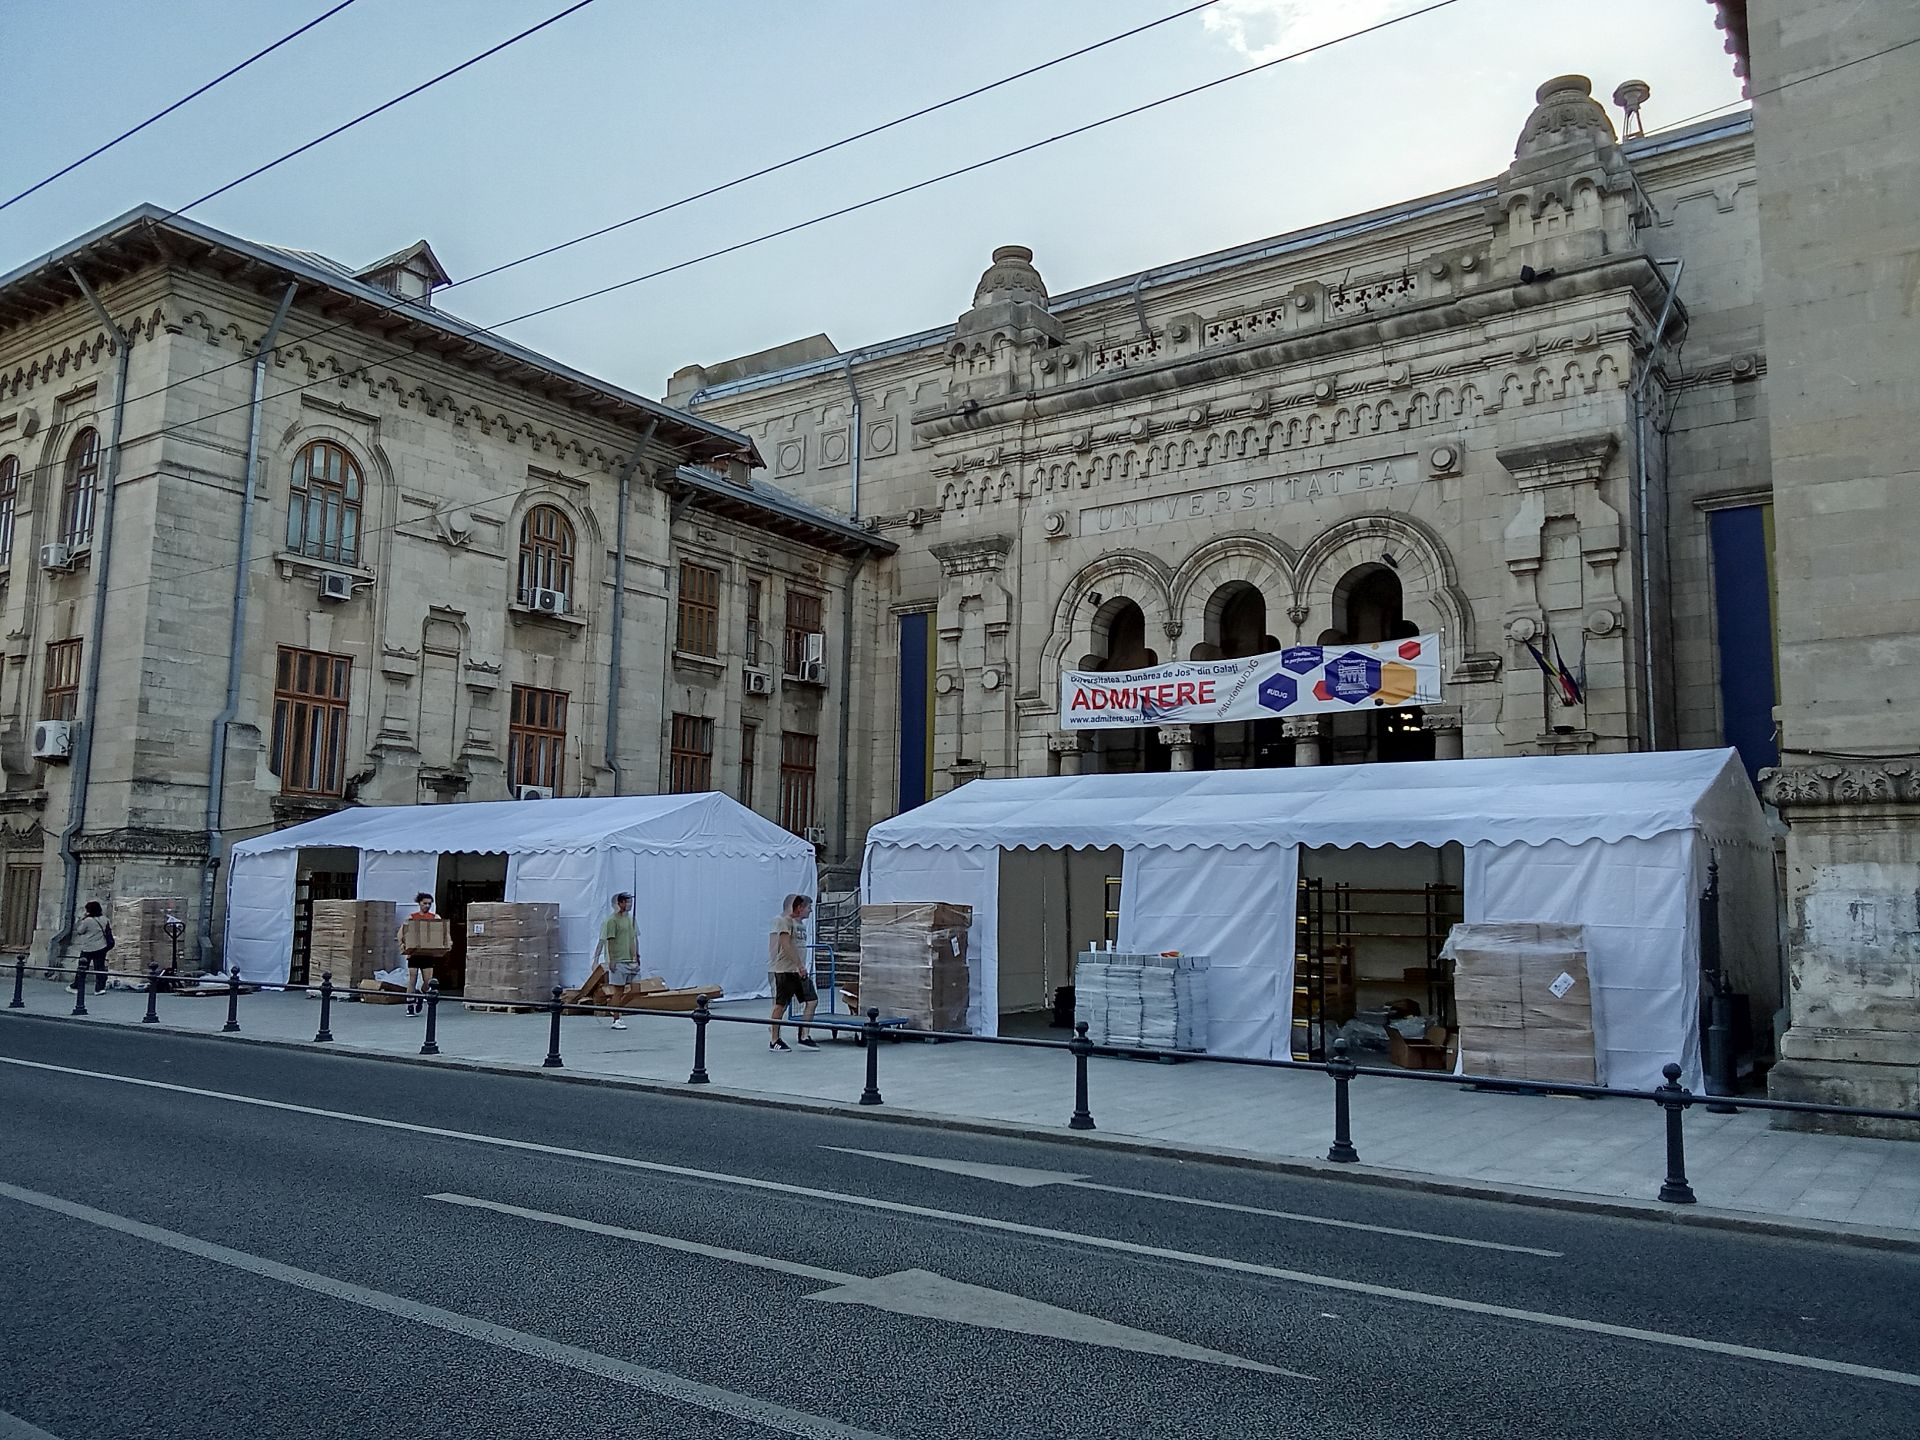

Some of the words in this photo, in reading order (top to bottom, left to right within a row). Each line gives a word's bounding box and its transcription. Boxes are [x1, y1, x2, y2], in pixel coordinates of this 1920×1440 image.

[1097, 461, 1398, 532] UNIVERSITATEA
[1163, 670, 1173, 678] de
[1197, 666, 1211, 675] din
[1071, 680, 1217, 711] ADMITERE
[1216, 659, 1260, 718] #studentUDJG
[1267, 688, 1288, 699] #UDJG
